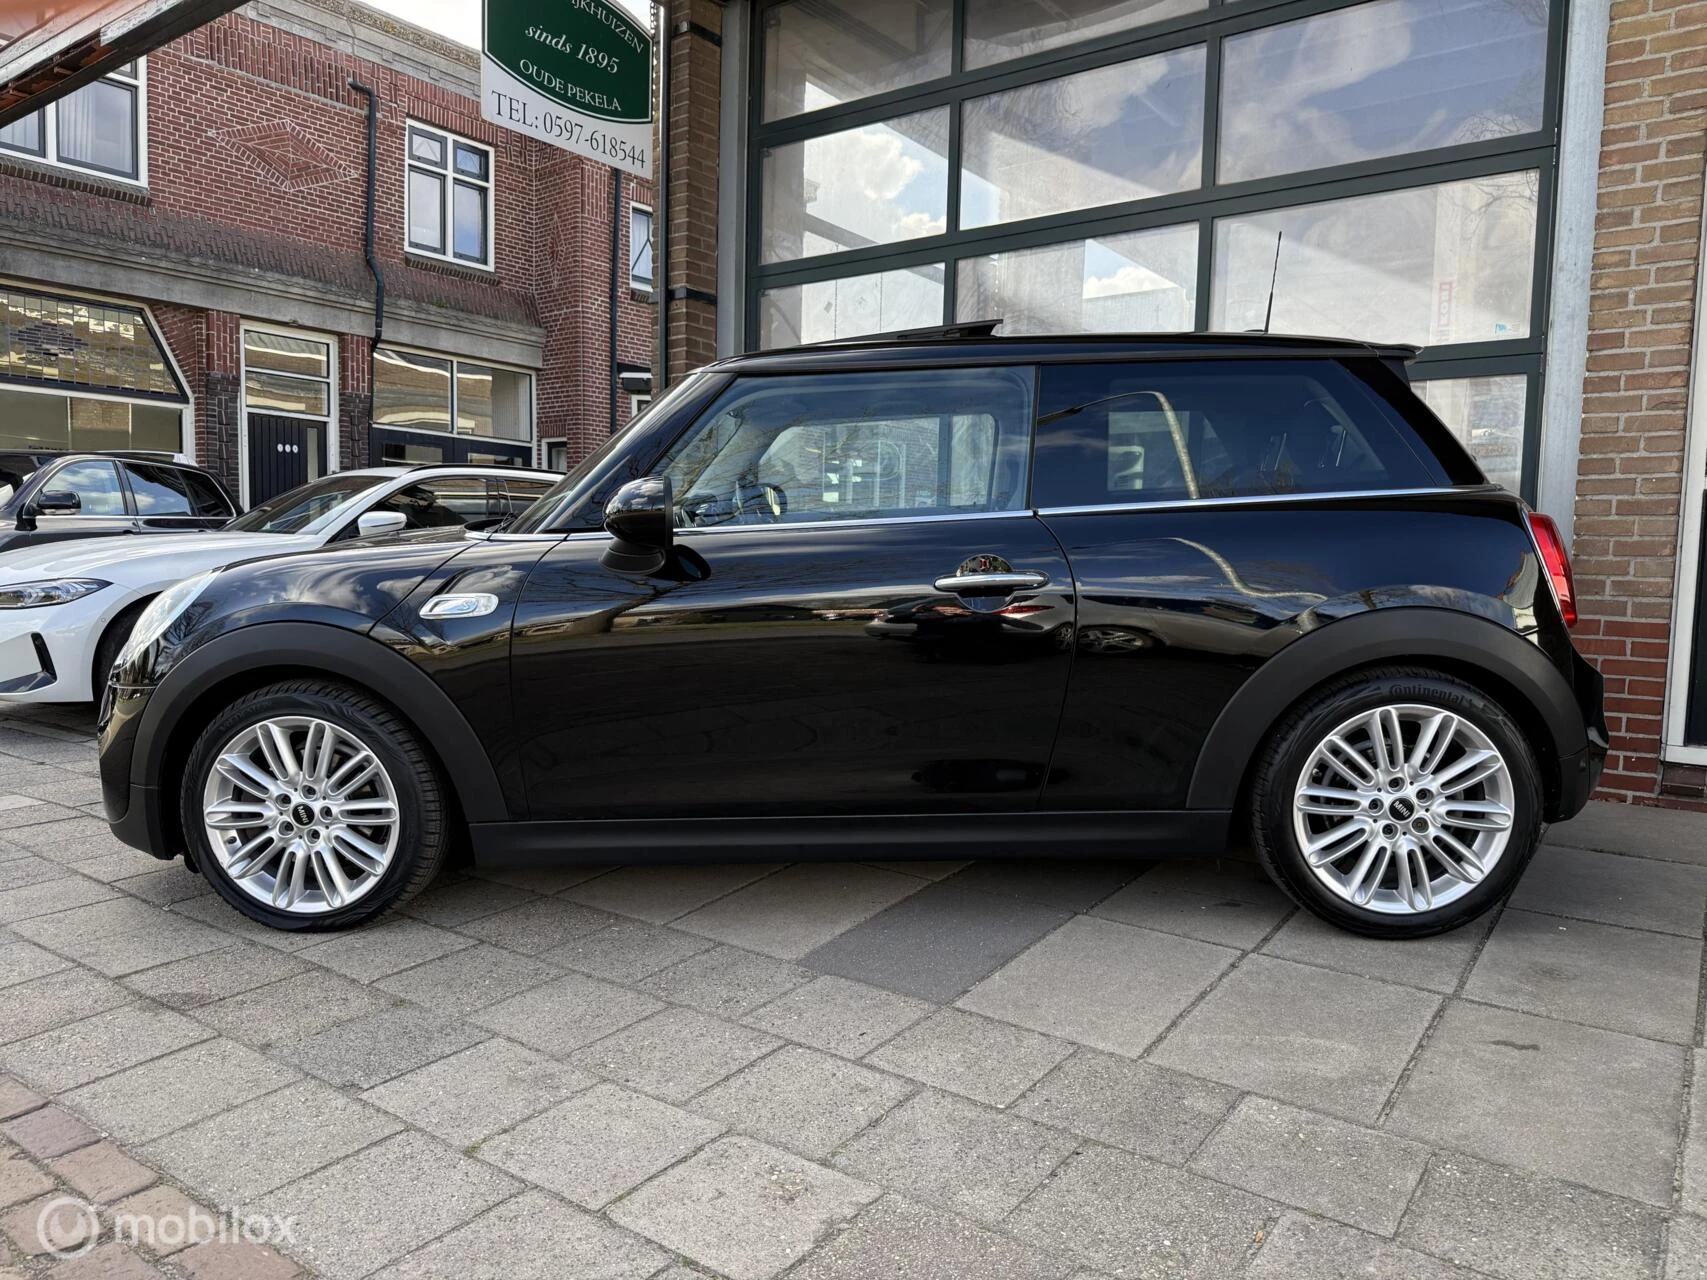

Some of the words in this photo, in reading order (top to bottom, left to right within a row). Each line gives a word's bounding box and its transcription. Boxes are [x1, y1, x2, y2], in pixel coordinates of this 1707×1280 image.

[525, 25, 573, 54] sinds
[575, 43, 620, 74] 1895
[519, 59, 565, 94] OUDE
[567, 83, 621, 111] PEKELA
[491, 90, 538, 129] TEL:
[543, 111, 646, 169] 0597-618544
[1389, 684, 1465, 704] Continental
[297, 805, 309, 822] MINI
[1393, 800, 1410, 817] MINI
